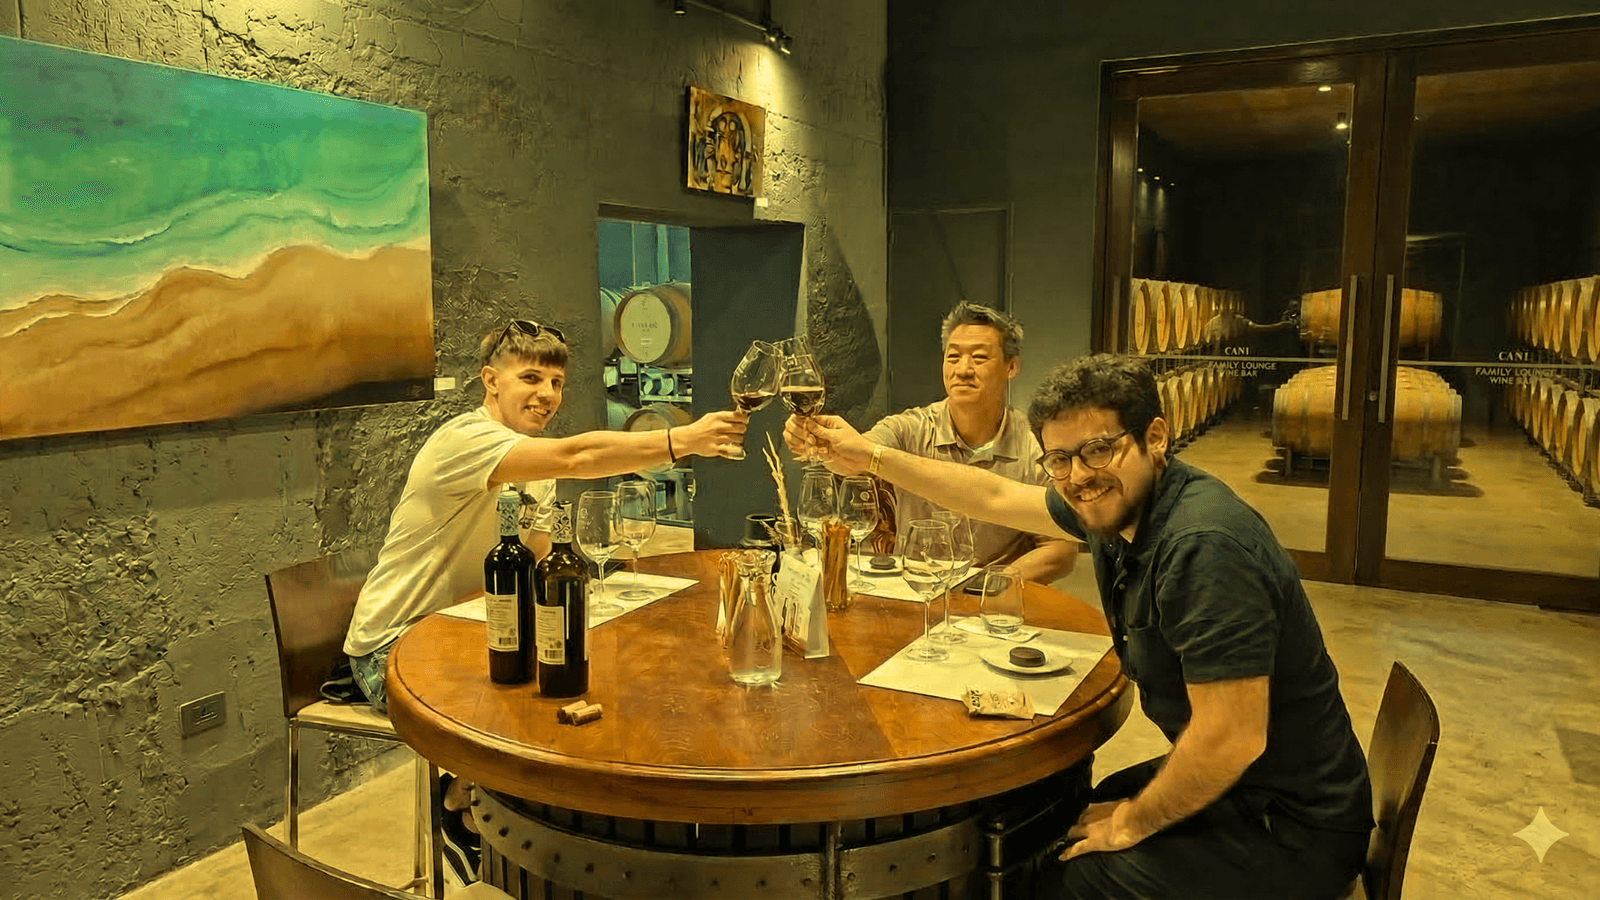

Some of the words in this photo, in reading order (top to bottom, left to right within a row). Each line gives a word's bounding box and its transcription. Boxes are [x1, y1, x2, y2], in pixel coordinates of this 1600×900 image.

[1224, 346, 1249, 355] CANI
[1498, 351, 1529, 361] CANI
[1208, 361, 1239, 369] FAMILY
[1241, 361, 1277, 370] LOUNGE
[1475, 367, 1511, 376] FAMILY
[1515, 368, 1557, 376] LOUNGE
[1489, 376, 1513, 384] WINE
